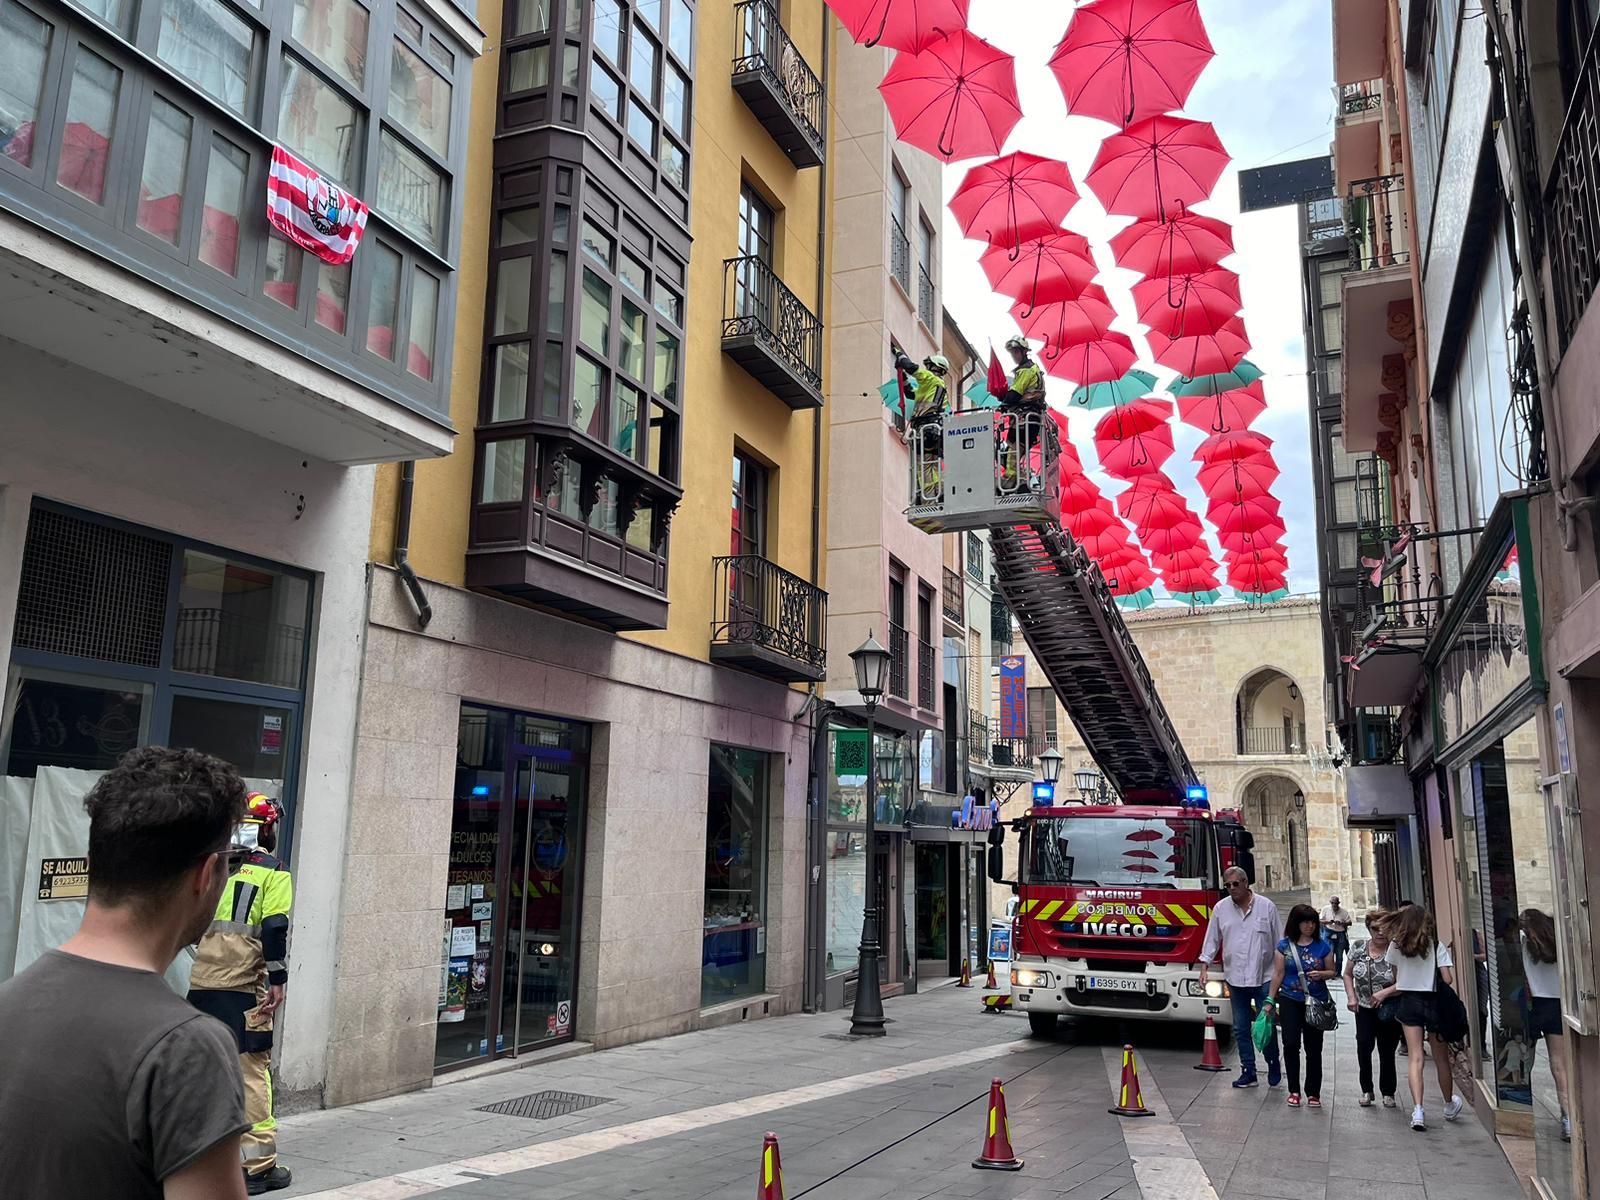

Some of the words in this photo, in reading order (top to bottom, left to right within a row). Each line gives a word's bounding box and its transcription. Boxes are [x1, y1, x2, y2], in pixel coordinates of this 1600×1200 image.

[947, 425, 989, 436] MAGIRUS
[1014, 676, 1024, 737] MALETAS
[456, 851, 492, 863] DULCES
[42, 861, 54, 875] SE
[1086, 890, 1142, 900] MAGIRUS
[1082, 922, 1148, 938] IVECO
[1096, 978, 1119, 988] 6395
[1120, 980, 1137, 990] GYX
